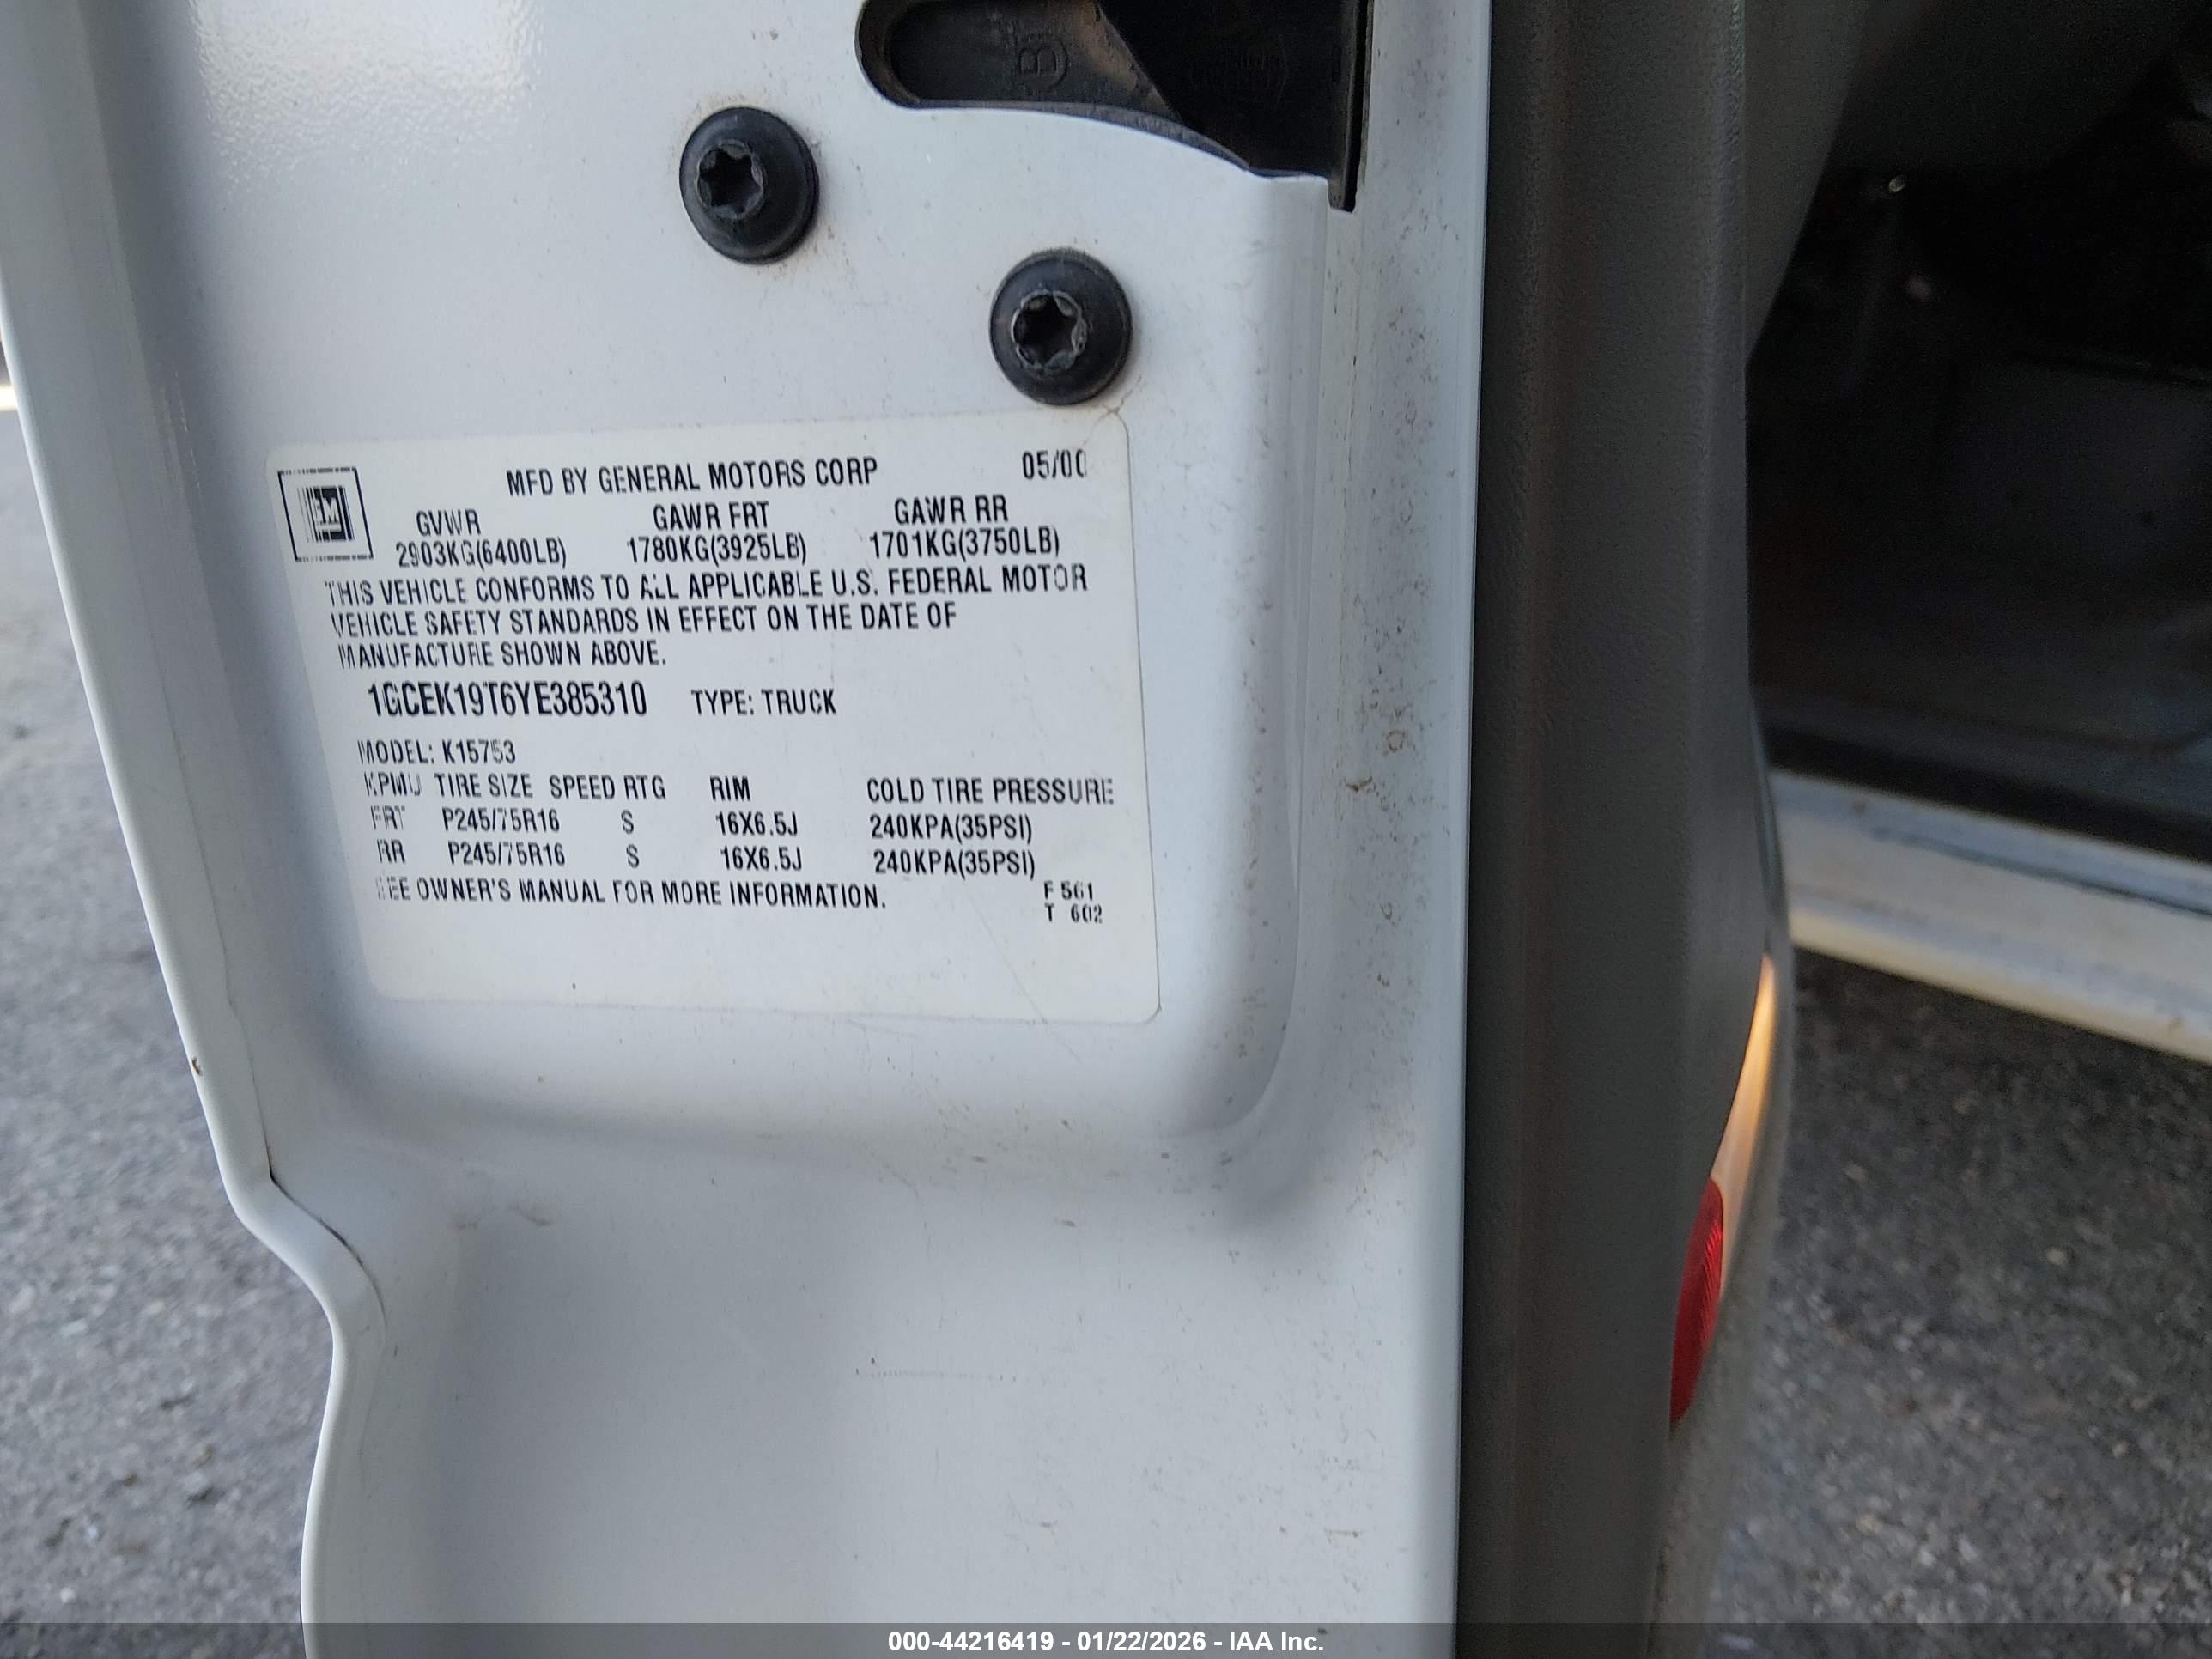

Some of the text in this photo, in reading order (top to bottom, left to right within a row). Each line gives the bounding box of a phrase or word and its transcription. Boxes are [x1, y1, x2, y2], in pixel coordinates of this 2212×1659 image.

[507, 456, 878, 496] MFD BY GENERAL MOTORS CORP
[416, 508, 481, 537] GVWR
[653, 501, 769, 532] GAWR FRT
[894, 494, 1008, 526] GAWR RR
[396, 537, 566, 572] 2903KG(6400LB)
[627, 532, 806, 568] 1780KG(3925LB)
[869, 526, 1060, 562] 1701KG(3750LB)
[325, 563, 1087, 607] THIS VEHICLE CONFORMS TO ALL APPLICABLE U.S. FEDERAL MOTOR
[331, 601, 956, 639] VEHICLE SAFETY STANDARDS IN EFFECT ON THE DATE OF
[337, 639, 666, 670] MANUFACTURE SHOWN ABOVE.
[368, 680, 647, 717] 1GCEK19T6YE385310
[691, 688, 836, 716] TYPE: TRUCK
[357, 738, 515, 764] MODEL: K15753
[434, 773, 665, 800] TIRE SIZE SPEED RTG
[710, 775, 750, 802] RIM
[867, 777, 1114, 805] COLD TIRE PRESSURE
[371, 805, 405, 830] FRT
[442, 806, 559, 833] P245/75R16
[622, 811, 634, 835] S
[715, 811, 798, 836] 16X6.5J
[870, 813, 1032, 845] 240KPA(35PSI)
[377, 839, 405, 863] RR
[448, 840, 565, 866] P245/75R16
[627, 844, 639, 868] S
[720, 845, 802, 872] 16X6.5J
[873, 848, 1035, 881] 240KPA(35PSI)
[417, 877, 511, 902] OWNER'S
[519, 878, 605, 903] MANUAL
[613, 879, 654, 904] FOR
[661, 880, 721, 905] MORE
[730, 881, 885, 909] INFORMATION.
[1044, 880, 1054, 900] F
[1044, 902, 1054, 922] T
